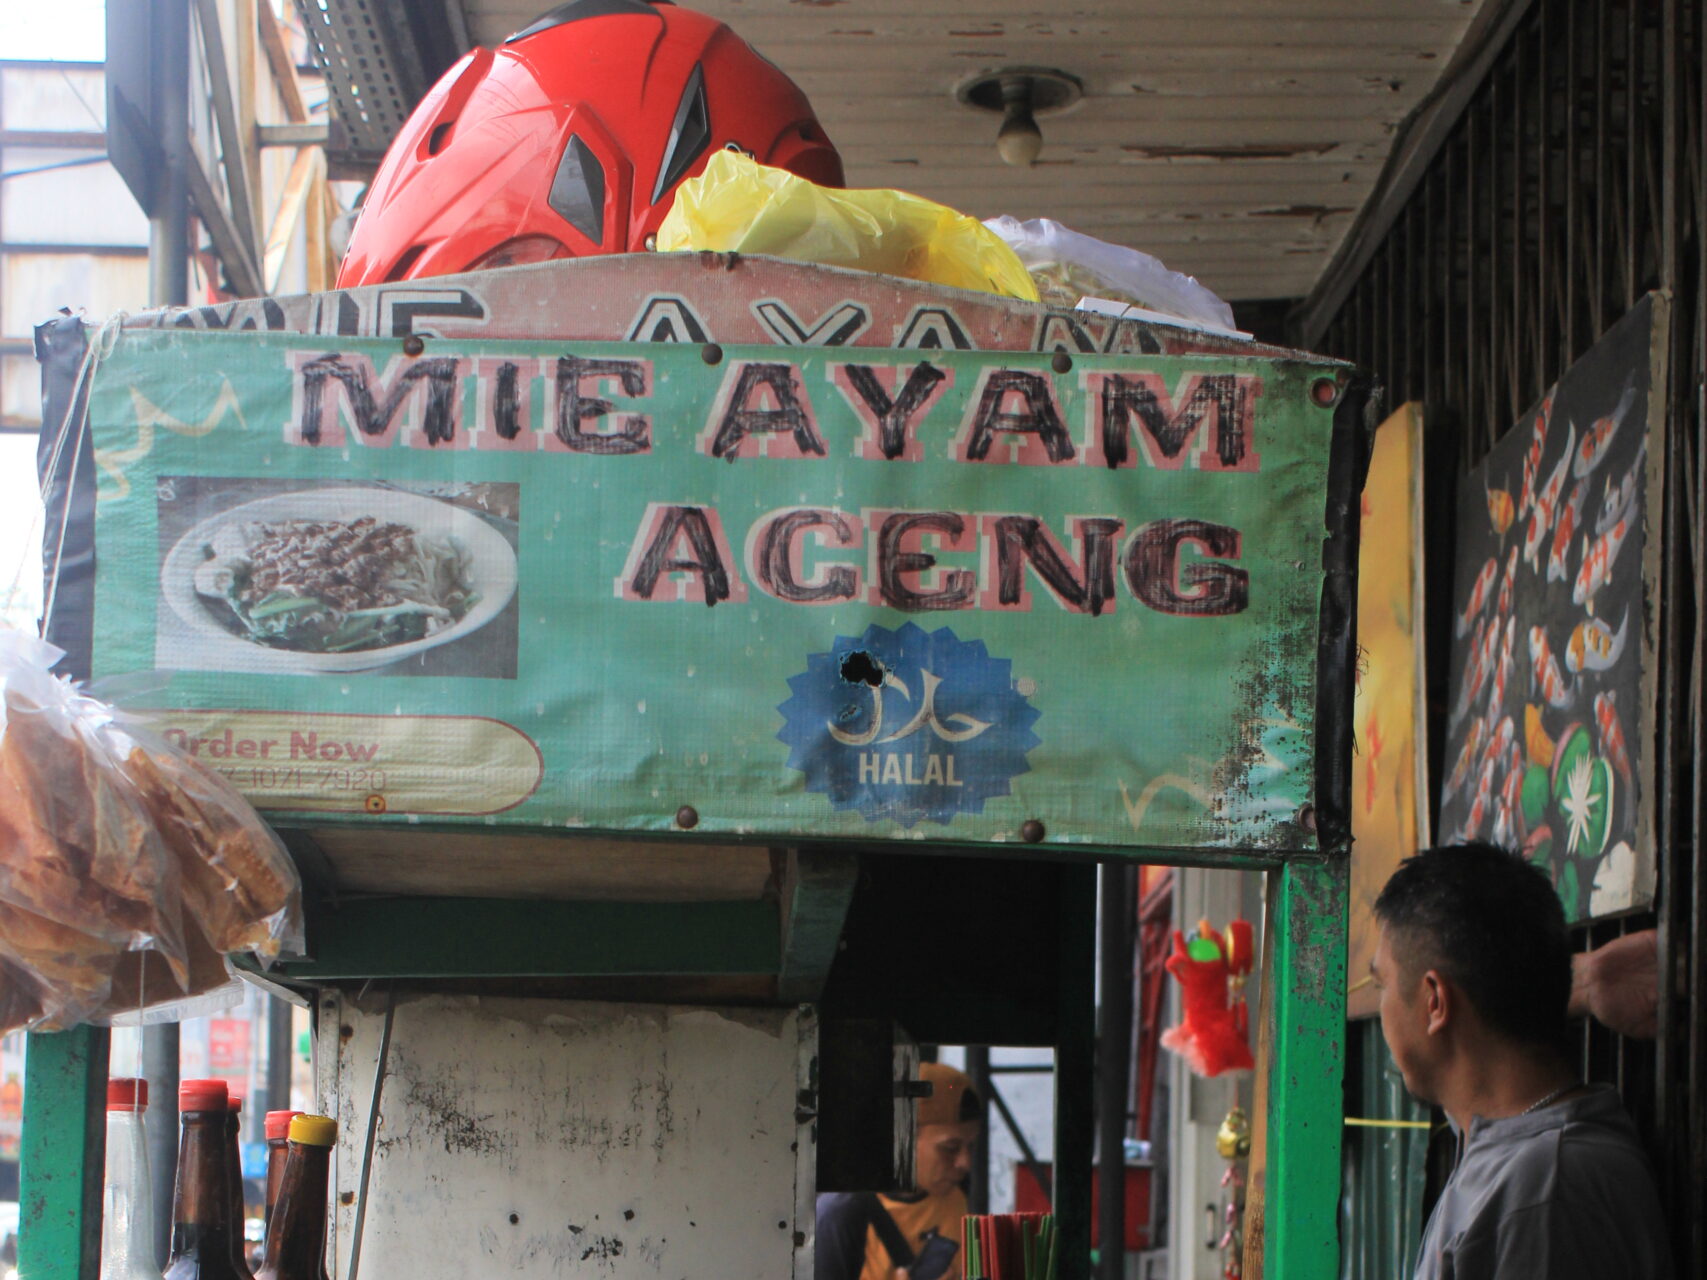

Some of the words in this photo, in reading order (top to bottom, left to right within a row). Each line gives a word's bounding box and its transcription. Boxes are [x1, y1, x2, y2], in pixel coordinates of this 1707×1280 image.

[284, 350, 653, 455] MIE
[697, 359, 1262, 473] AYAM
[613, 503, 1251, 617] ACENG
[162, 727, 279, 759] Order
[289, 731, 380, 761] Now
[858, 753, 964, 787] HALAL
